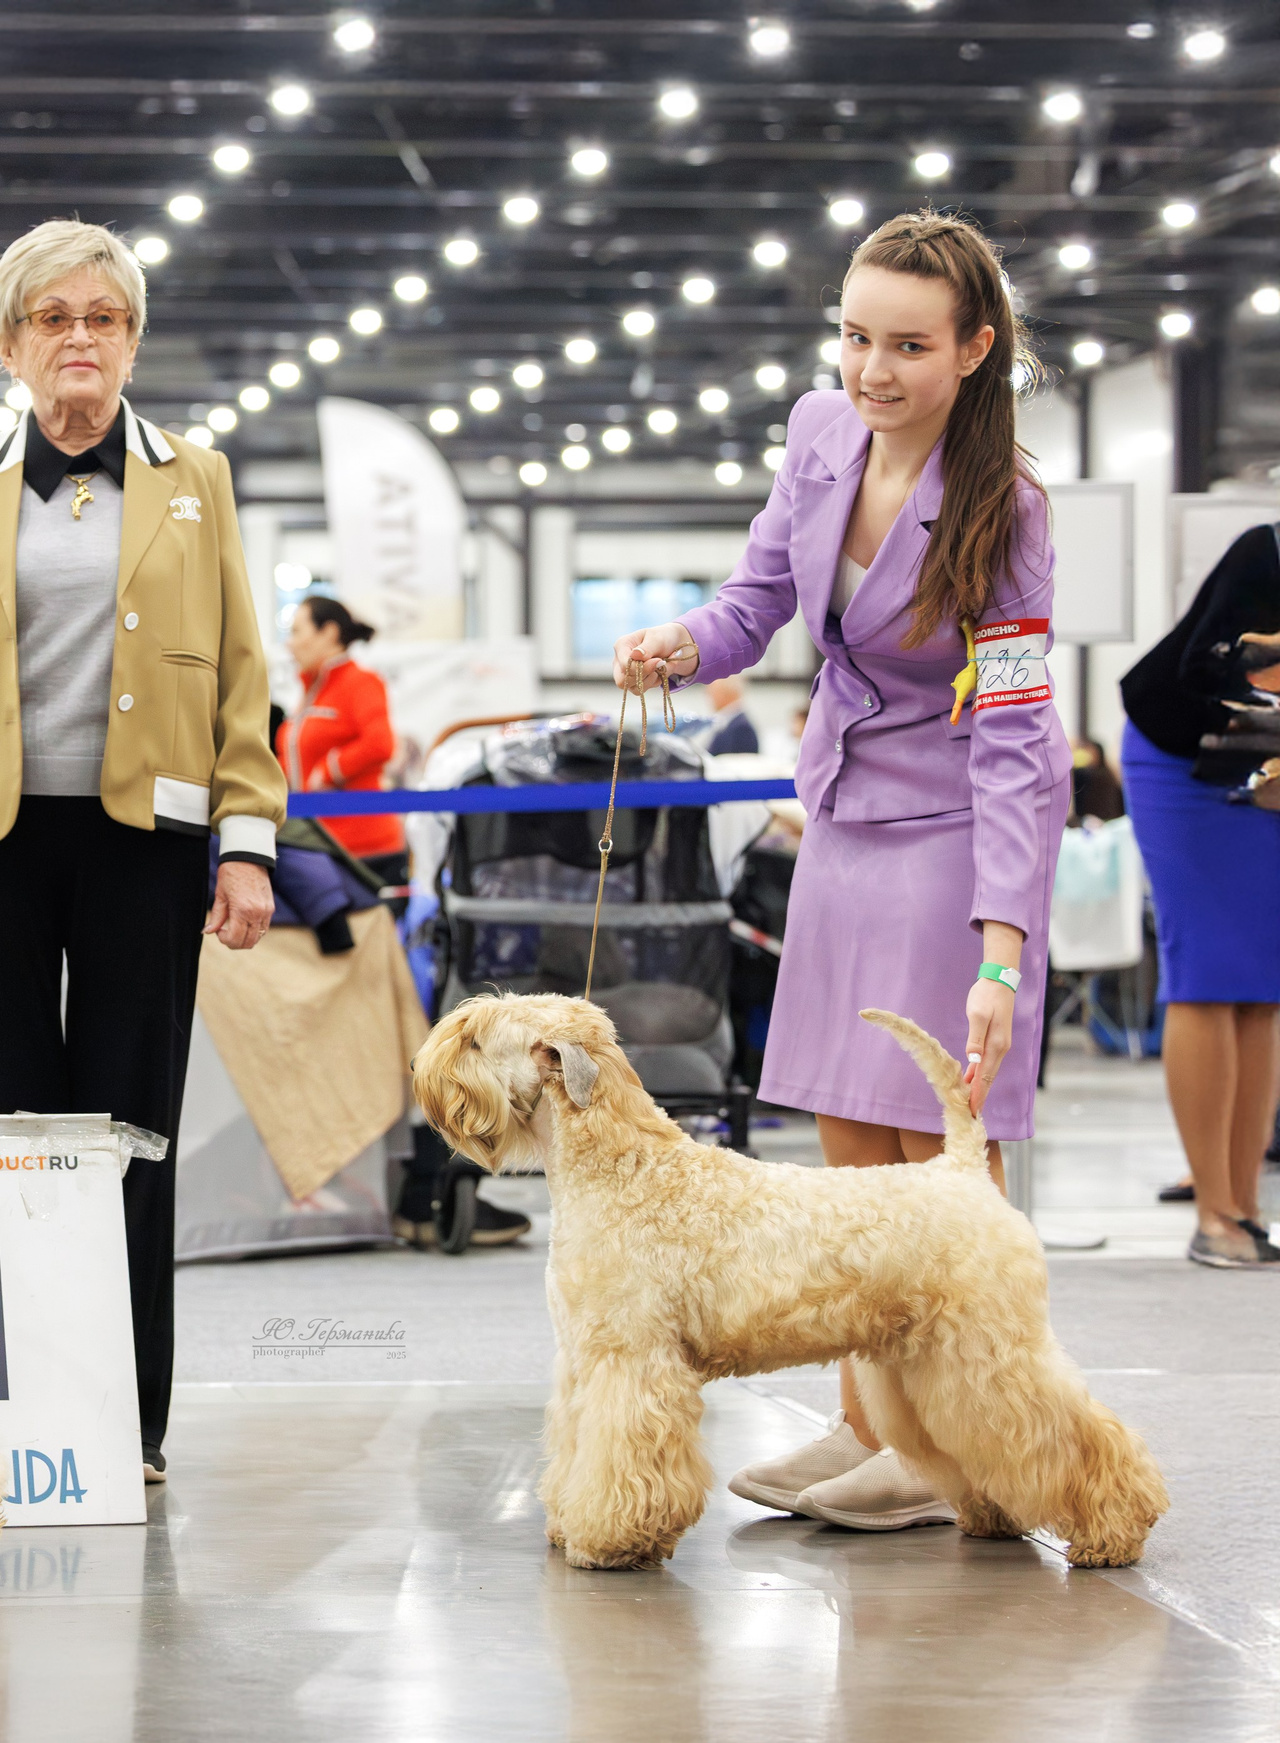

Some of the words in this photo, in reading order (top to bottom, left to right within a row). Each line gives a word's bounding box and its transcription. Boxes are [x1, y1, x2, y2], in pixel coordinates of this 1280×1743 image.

[982, 696, 993, 704] НА
[994, 692, 1023, 702] НАШЕМ
[1024, 688, 1049, 699] СТЕНДЕ
